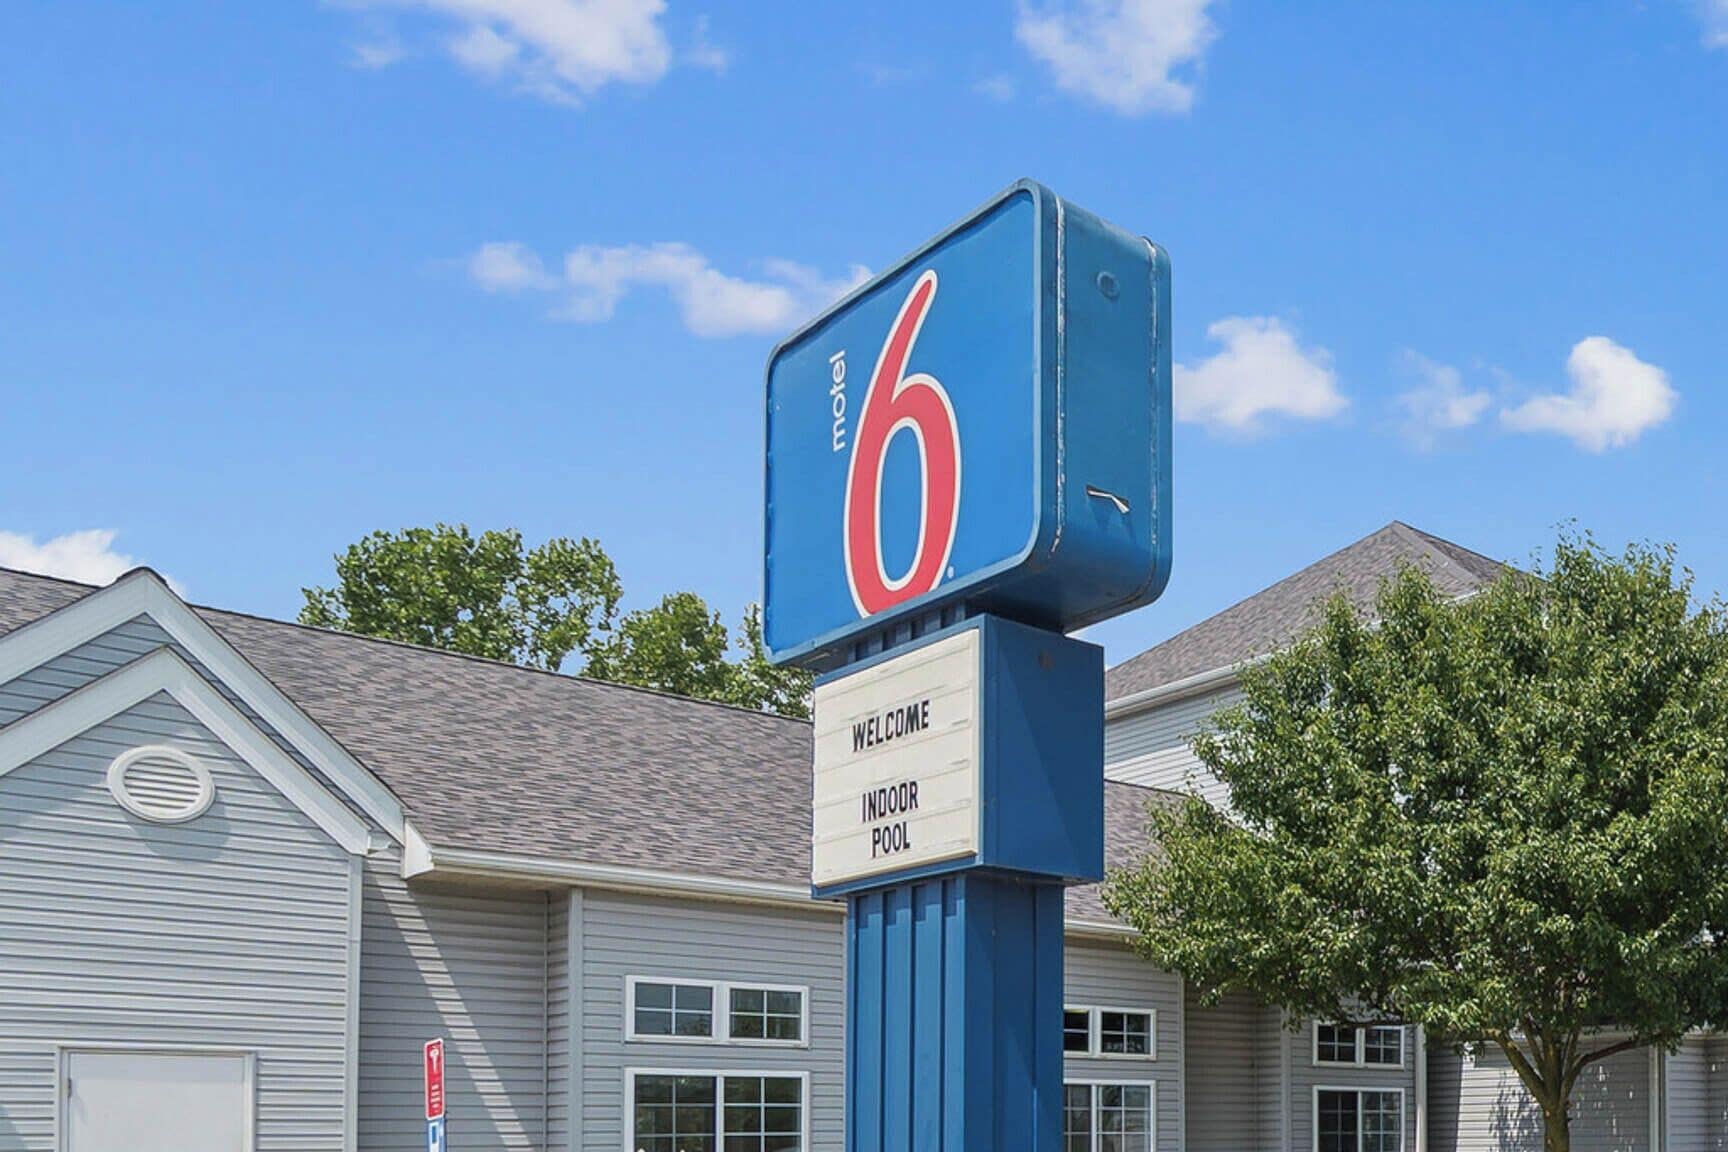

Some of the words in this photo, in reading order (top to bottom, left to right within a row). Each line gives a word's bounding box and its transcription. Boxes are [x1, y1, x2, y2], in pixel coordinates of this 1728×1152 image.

[829, 350, 847, 452] motel
[844, 268, 962, 620] 6
[852, 699, 930, 753] WELCOME
[862, 780, 919, 824] INDOOR
[871, 821, 911, 859] POOL
